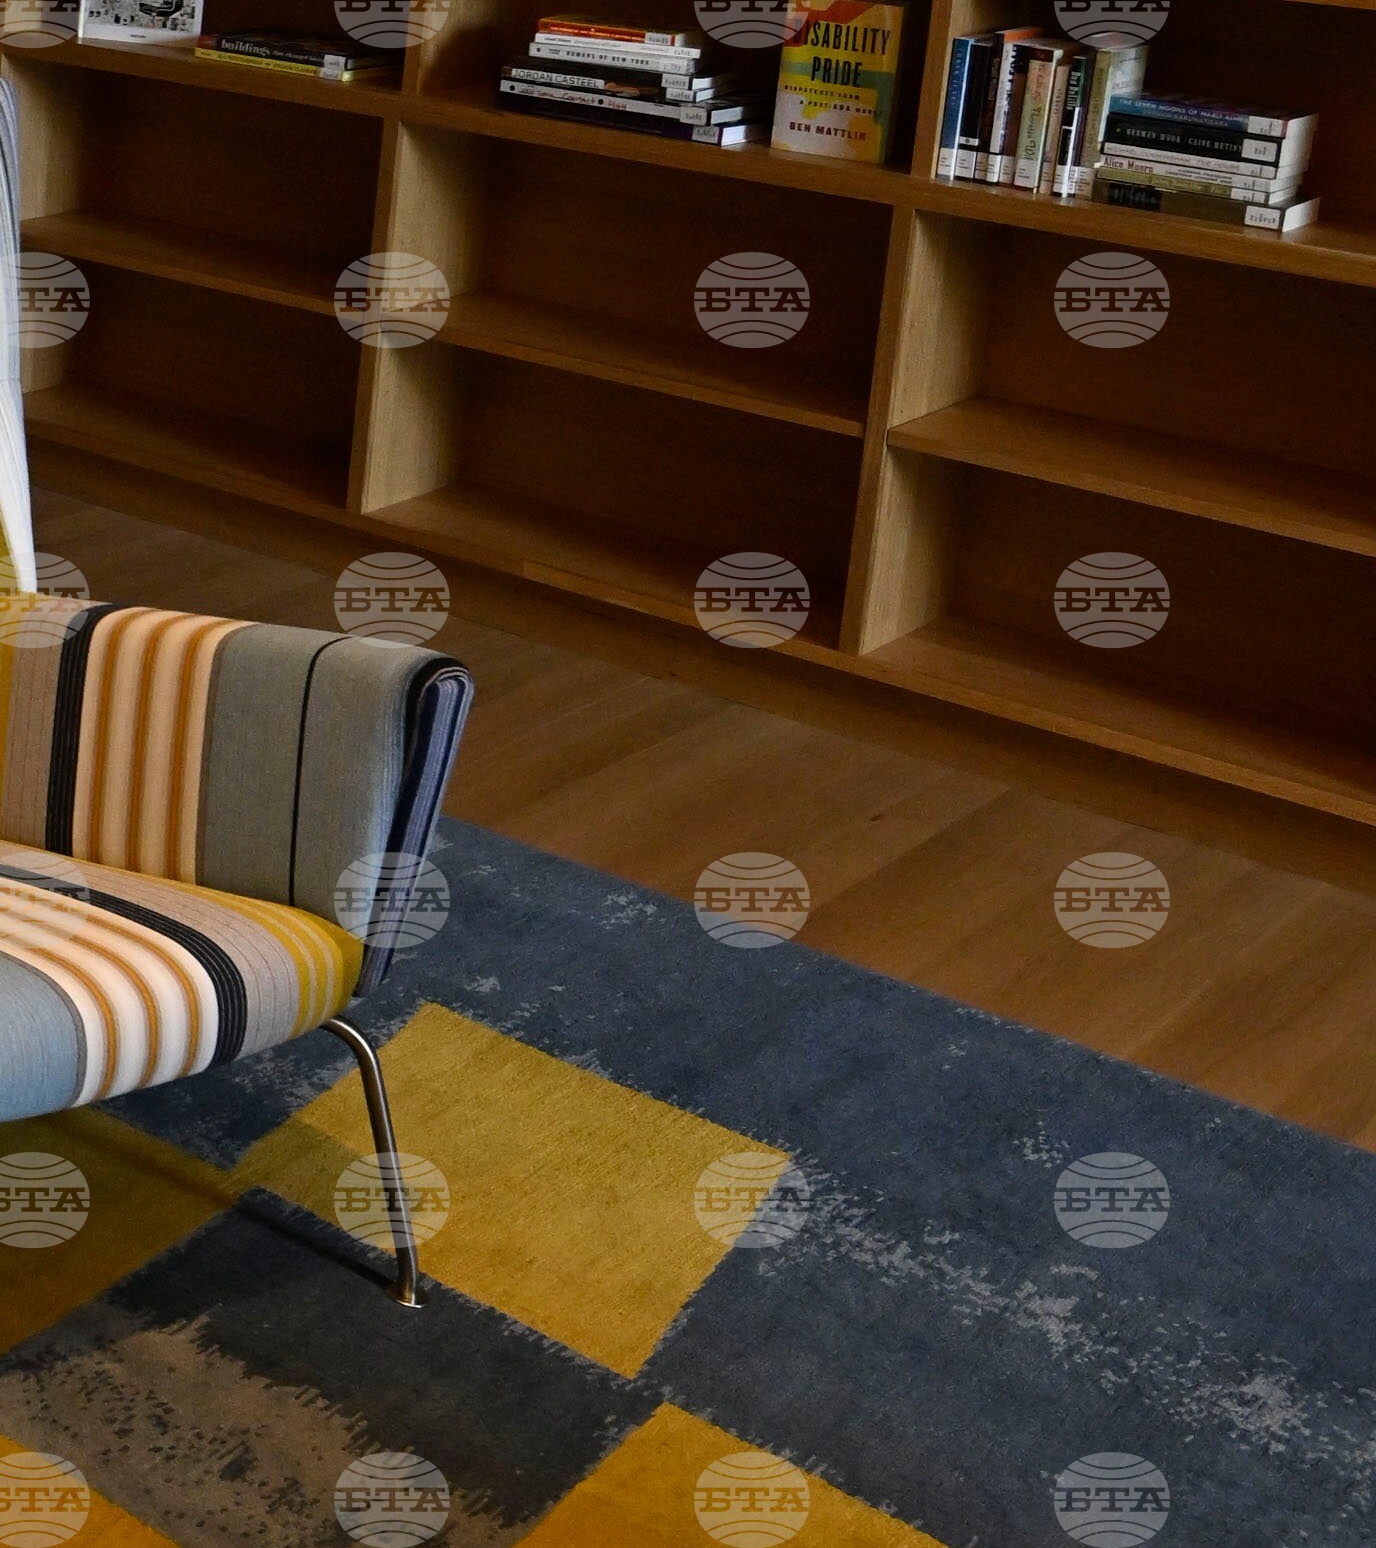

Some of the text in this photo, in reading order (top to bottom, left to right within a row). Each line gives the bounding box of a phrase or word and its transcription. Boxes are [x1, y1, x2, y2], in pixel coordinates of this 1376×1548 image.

[793, 18, 891, 55] DISABILITY
[221, 39, 271, 57] buildings
[631, 57, 650, 65] YORK
[512, 69, 599, 88] JORDAN CASTEEL
[811, 56, 863, 88] PRIDE
[789, 122, 867, 141] BEN MATTLIN
[1103, 157, 1154, 174] Alice Munro
